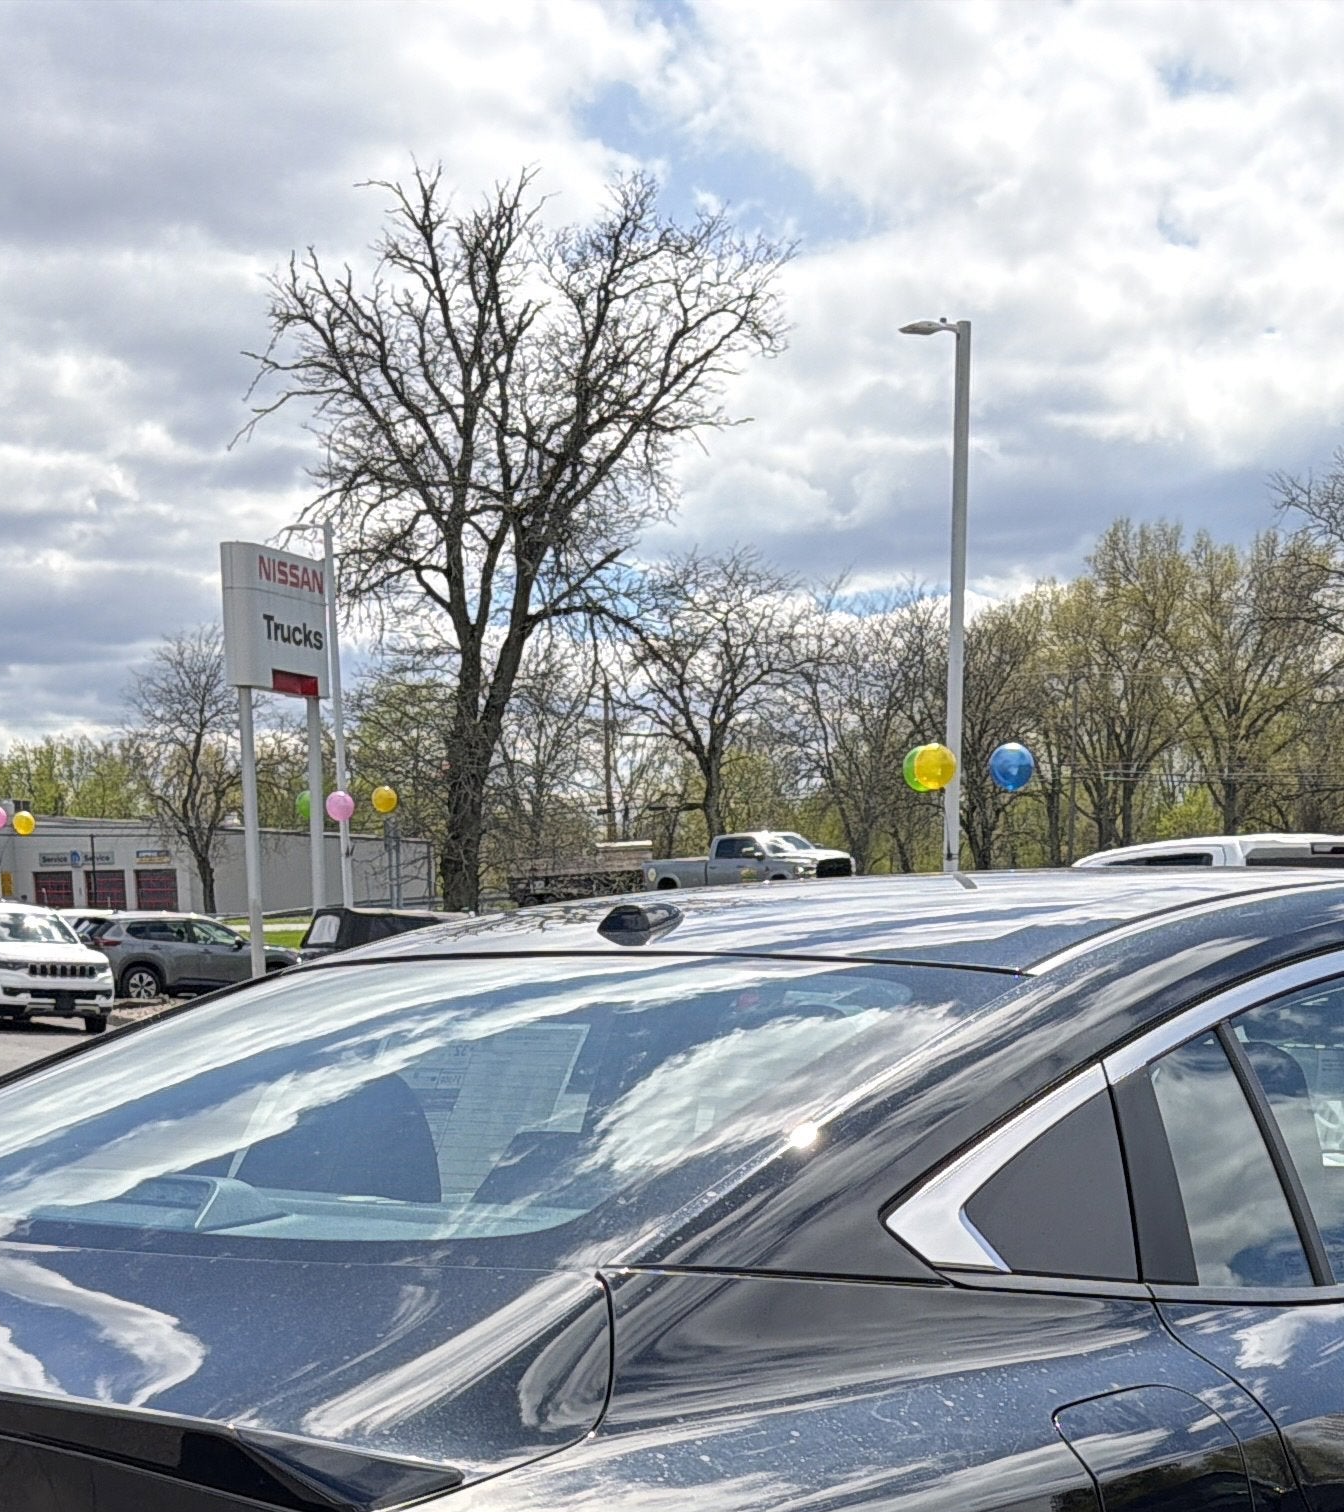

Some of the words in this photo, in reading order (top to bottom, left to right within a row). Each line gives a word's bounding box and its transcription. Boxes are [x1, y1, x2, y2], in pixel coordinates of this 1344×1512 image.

[258, 555, 324, 595] NISSAN
[262, 613, 324, 651] Trucks
[83, 854, 111, 862] Sevice
